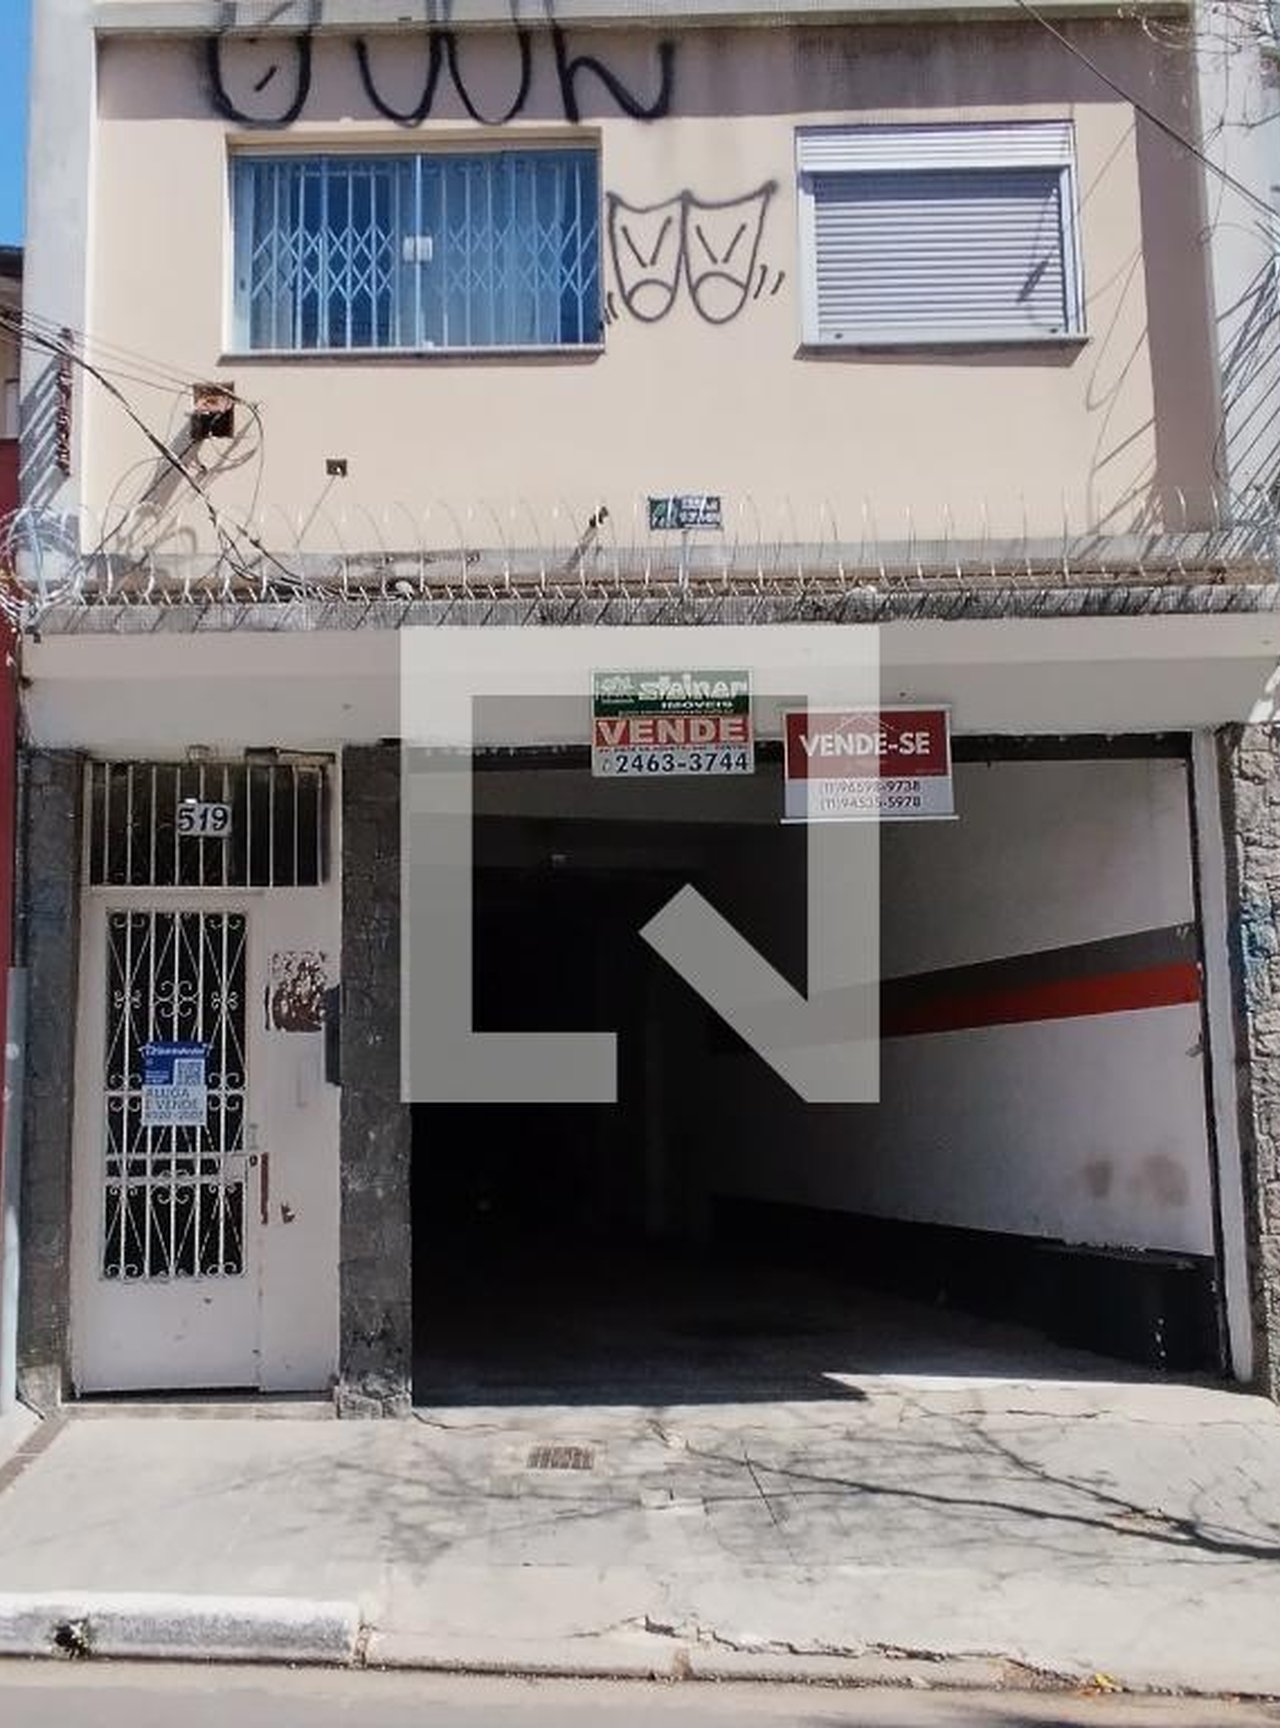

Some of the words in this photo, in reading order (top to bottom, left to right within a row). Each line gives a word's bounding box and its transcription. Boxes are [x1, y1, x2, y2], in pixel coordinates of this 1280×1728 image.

[597, 719, 745, 745] VENDE
[799, 731, 930, 757] VENDE-SE
[616, 753, 748, 774] 2463-3744
[178, 807, 229, 832] 519
